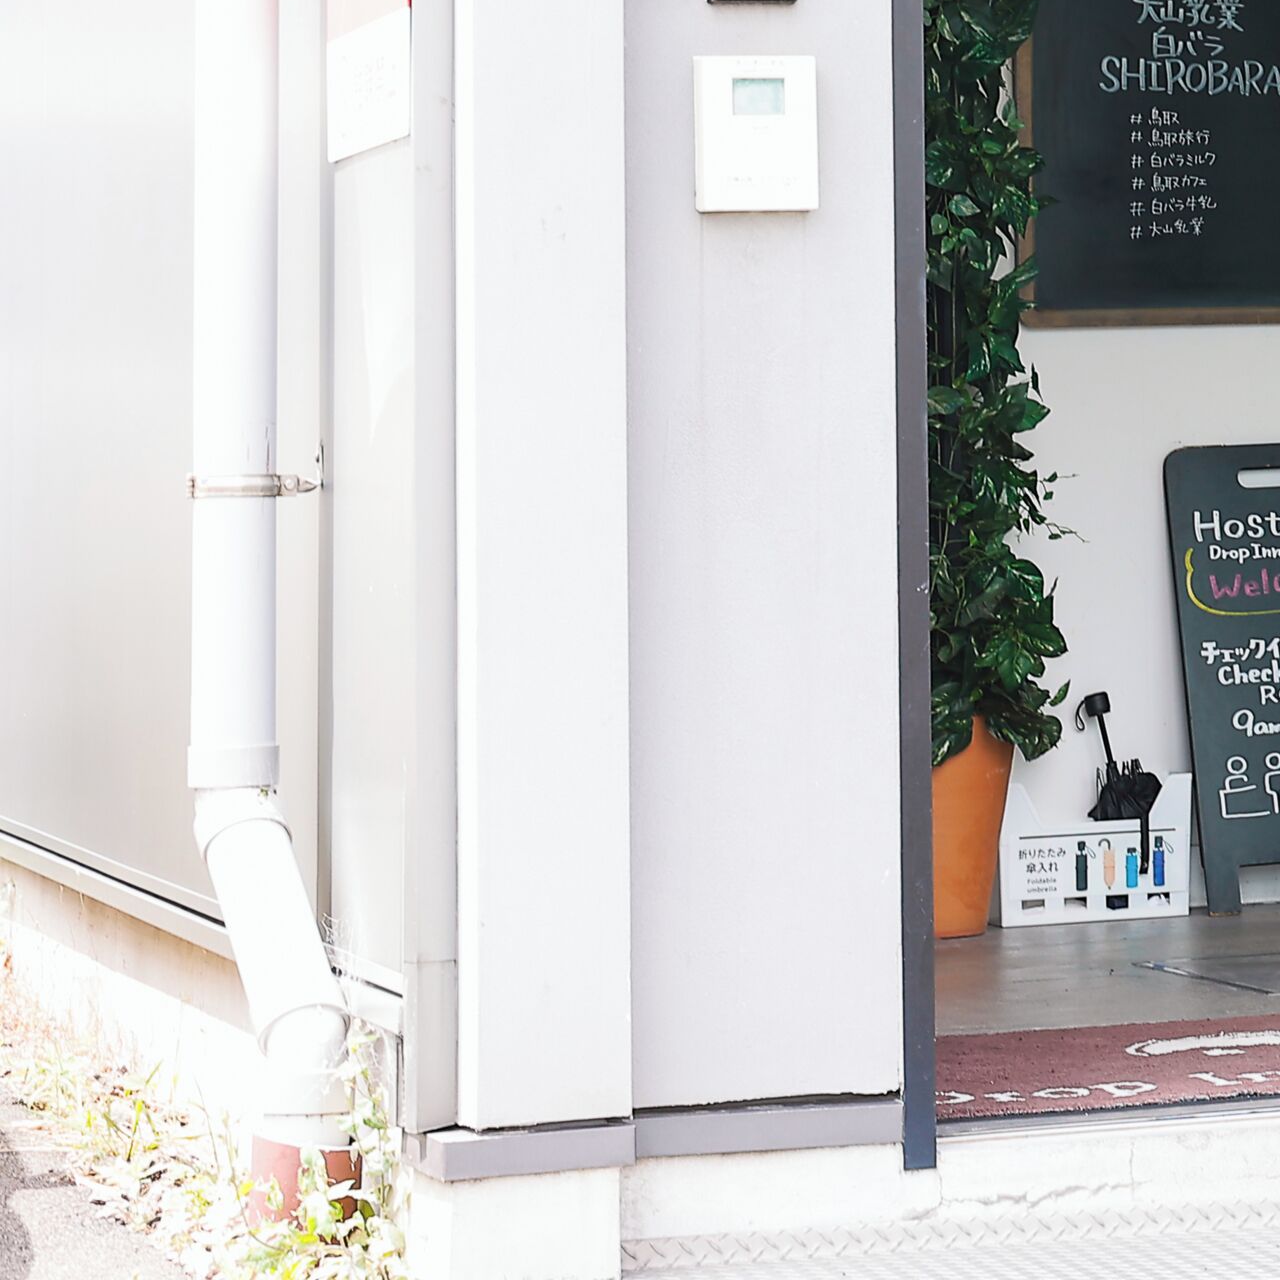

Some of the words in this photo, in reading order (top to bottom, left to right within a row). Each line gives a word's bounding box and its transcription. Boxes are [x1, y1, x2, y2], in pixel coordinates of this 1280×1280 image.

[1153, 27, 1224, 58] 白バラ
[1209, 544, 1250, 564] Drop
[1018, 847, 1066, 860] 折りたたみ
[1027, 862, 1059, 873] 傘入れ
